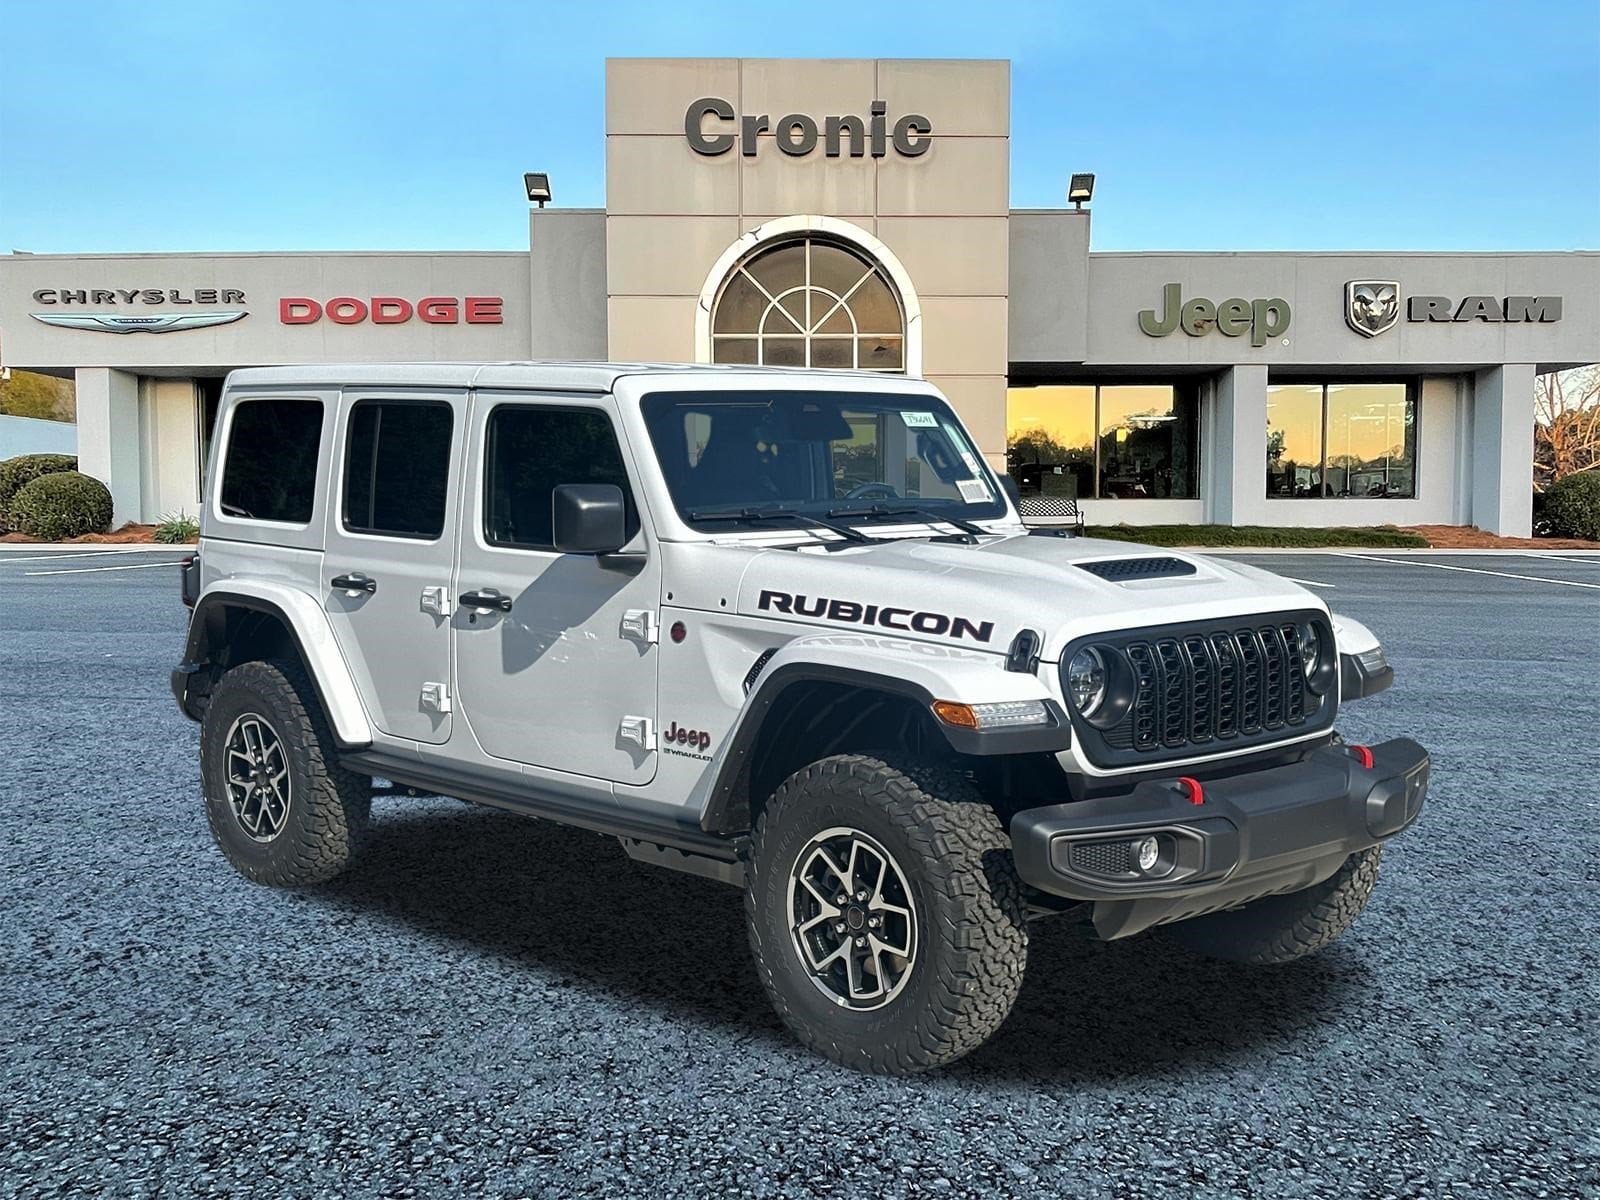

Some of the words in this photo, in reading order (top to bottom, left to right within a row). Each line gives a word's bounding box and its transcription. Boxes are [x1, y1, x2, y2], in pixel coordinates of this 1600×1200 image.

[684, 97, 933, 158] Cronic
[32, 288, 247, 305] CHRYSLER
[279, 297, 504, 325] DODGE
[1406, 296, 1563, 323] RAM
[1138, 282, 1291, 347] Jeep
[757, 589, 995, 643] RUBICON
[664, 721, 711, 752] Jeep
